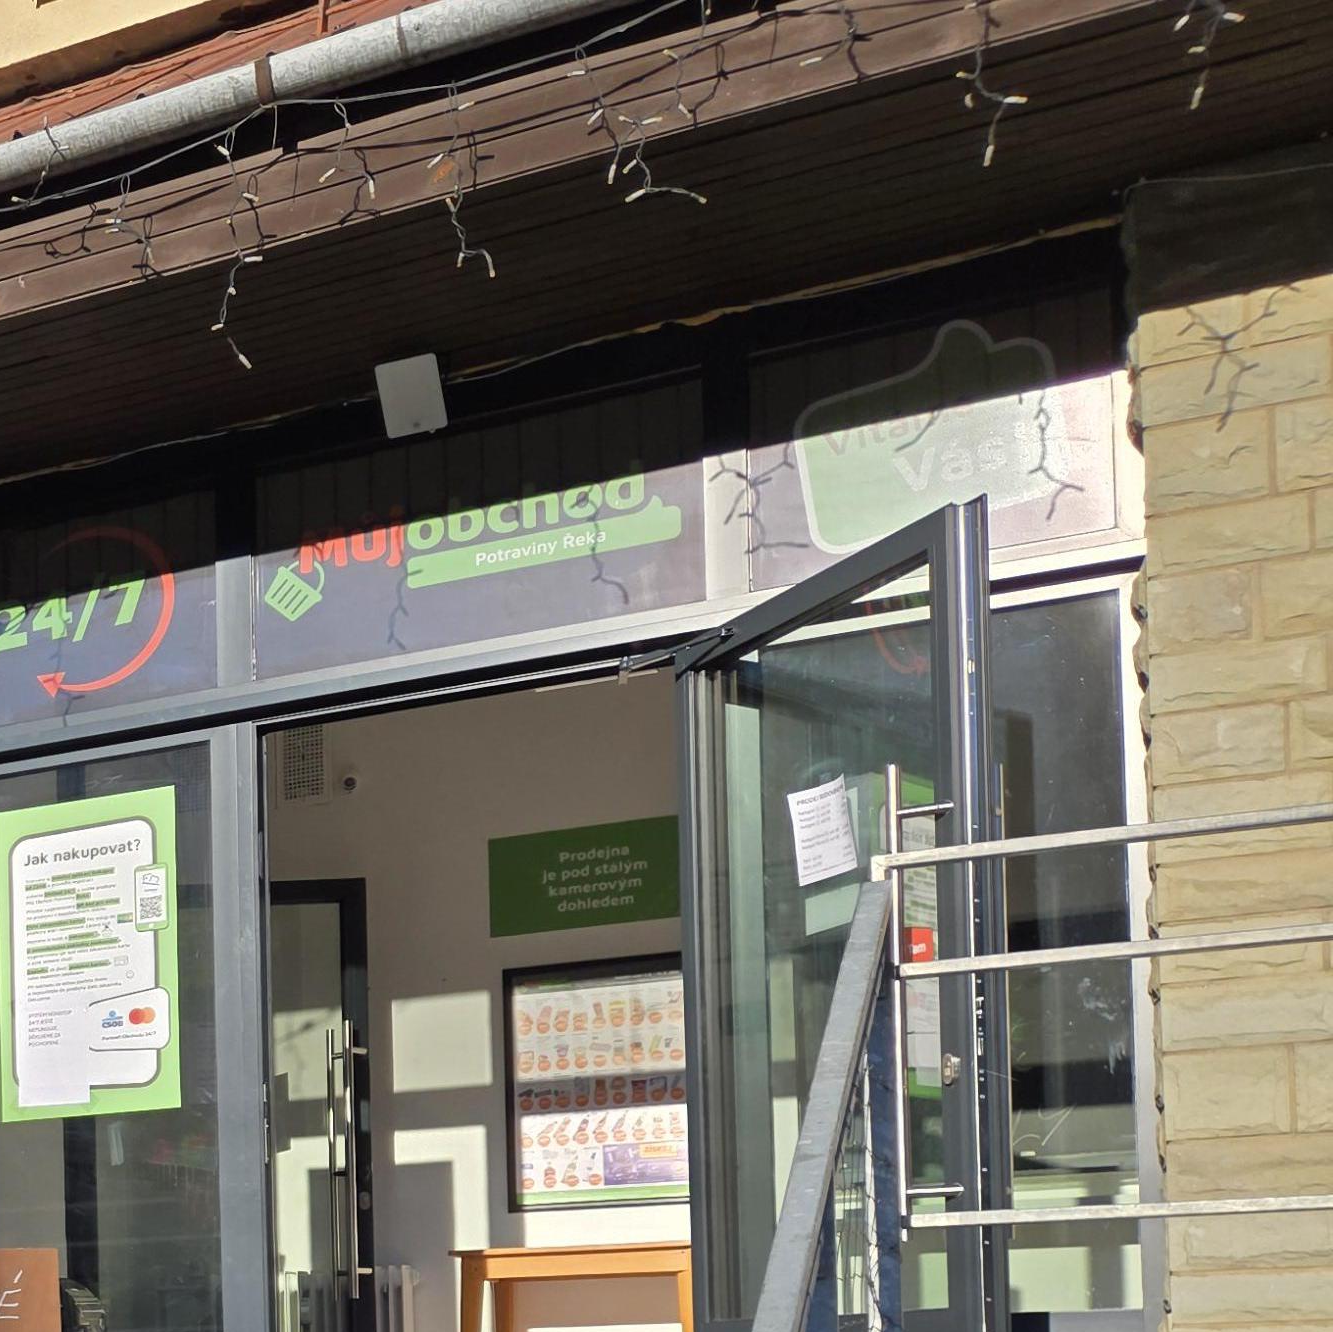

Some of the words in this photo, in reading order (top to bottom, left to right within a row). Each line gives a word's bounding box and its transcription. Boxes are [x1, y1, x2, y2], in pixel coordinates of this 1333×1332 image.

[475, 539, 557, 567] Potraviny
[563, 529, 607, 549] Řeka
[24, 852, 48, 866] Jak
[53, 839, 141, 863] nakupovat?
[559, 846, 629, 862] Prodejna
[542, 869, 557, 884] je
[561, 865, 590, 881] pod
[548, 876, 642, 897] kamerovým
[557, 895, 634, 912] dohledem
